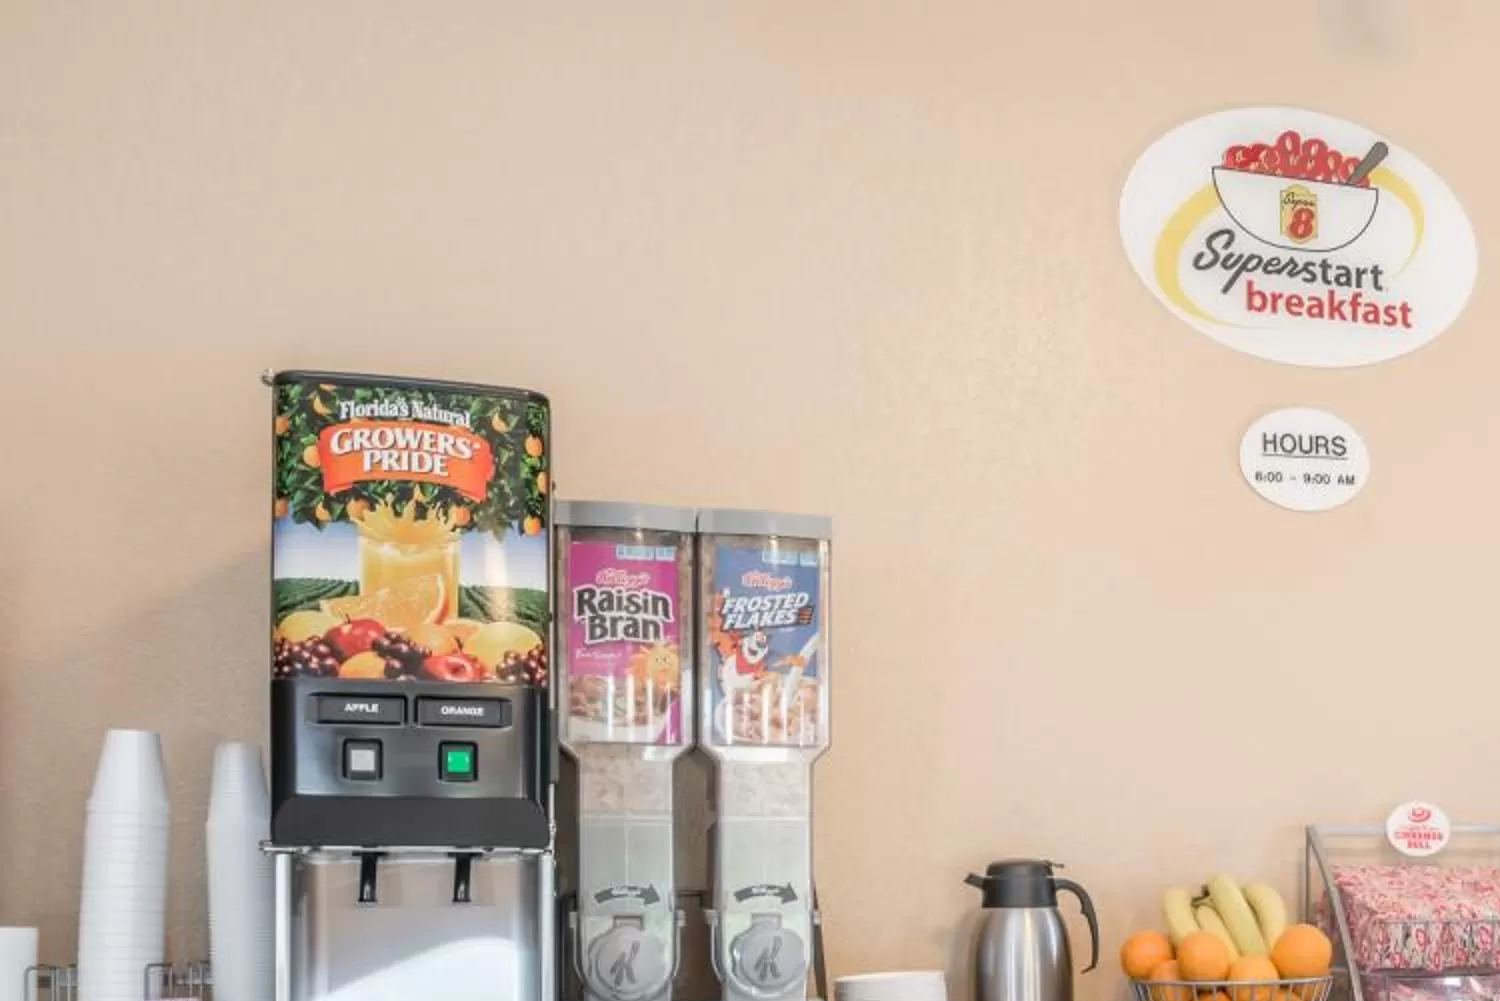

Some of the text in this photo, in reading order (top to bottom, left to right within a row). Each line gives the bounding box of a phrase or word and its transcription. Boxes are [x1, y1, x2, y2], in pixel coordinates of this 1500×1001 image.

[1289, 208, 1314, 240] 8
[1193, 229, 1384, 295] Superstart
[1245, 280, 1413, 329] breakfast
[339, 397, 471, 428] Florida's Natural
[1262, 431, 1348, 457] HOURS
[362, 449, 449, 477] PRIDE
[1337, 474, 1355, 485] AM
[575, 586, 672, 621] Raisin
[722, 592, 810, 615] FROSTED
[586, 613, 664, 643] Bran
[722, 608, 797, 630] FLAKES
[344, 703, 380, 714] APPLE
[440, 706, 485, 717] ORANGE
